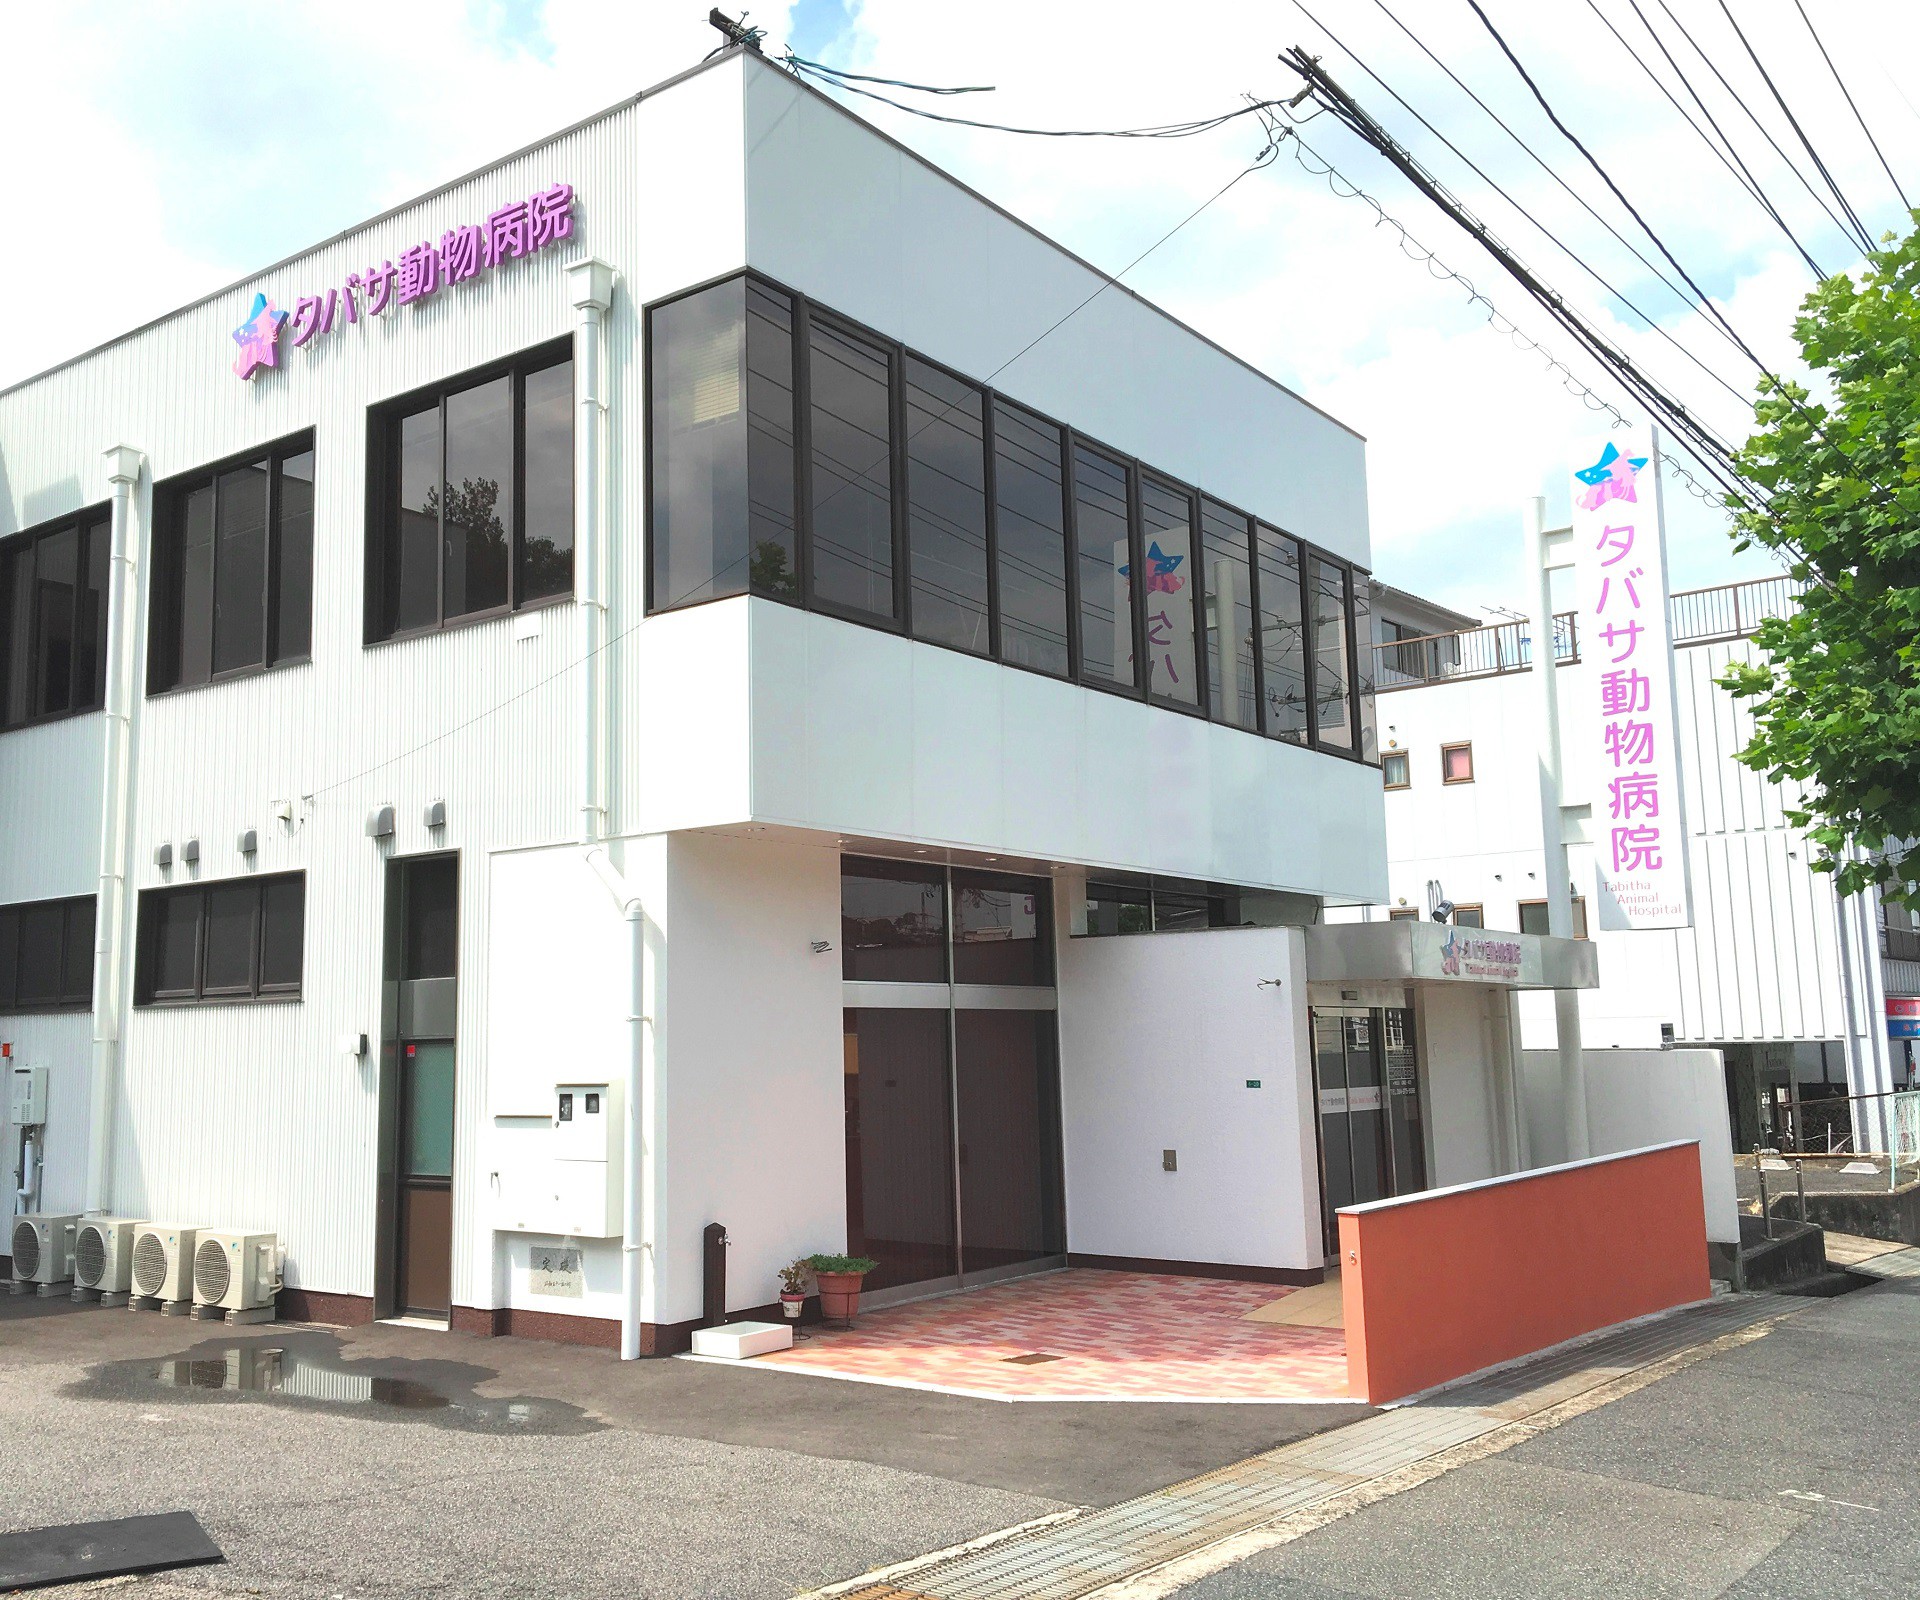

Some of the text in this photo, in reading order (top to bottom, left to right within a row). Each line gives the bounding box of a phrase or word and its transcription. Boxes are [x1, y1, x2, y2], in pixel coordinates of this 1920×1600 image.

[291, 182, 574, 347] タバサ動物病院
[1596, 524, 1662, 873] タバサ動物病院
[1603, 881, 1651, 892] Tabitha
[1617, 892, 1659, 904] Animal
[1629, 904, 1682, 917] Hospital
